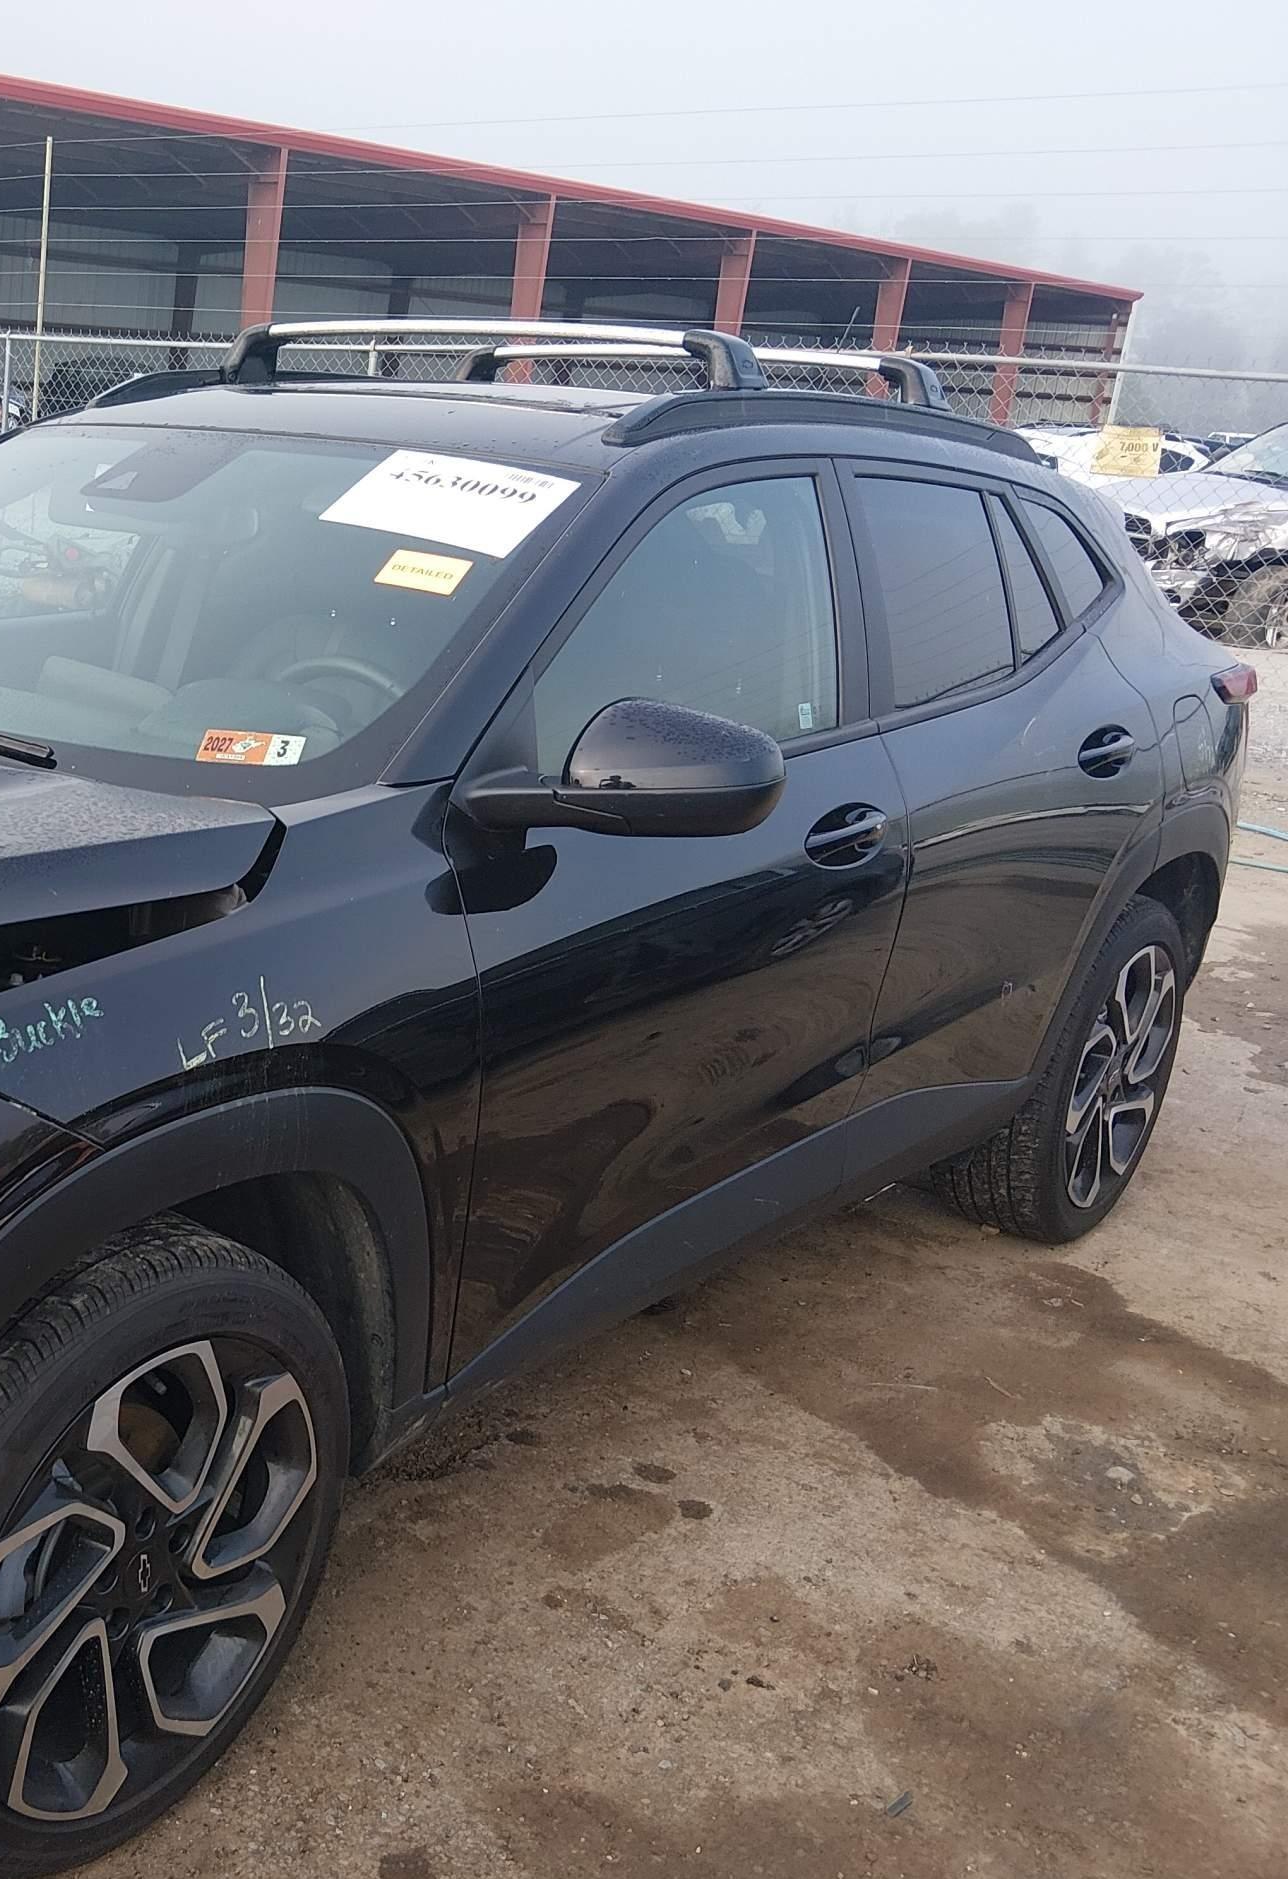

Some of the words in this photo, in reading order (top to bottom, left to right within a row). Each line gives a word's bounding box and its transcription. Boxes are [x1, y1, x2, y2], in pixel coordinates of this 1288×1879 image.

[389, 469, 537, 504] 45630099
[391, 563, 454, 581] DETAILED
[203, 736, 234, 752] 2027
[276, 740, 290, 758] 3
[177, 1017, 228, 1072] LF
[231, 975, 322, 1049] 3/32
